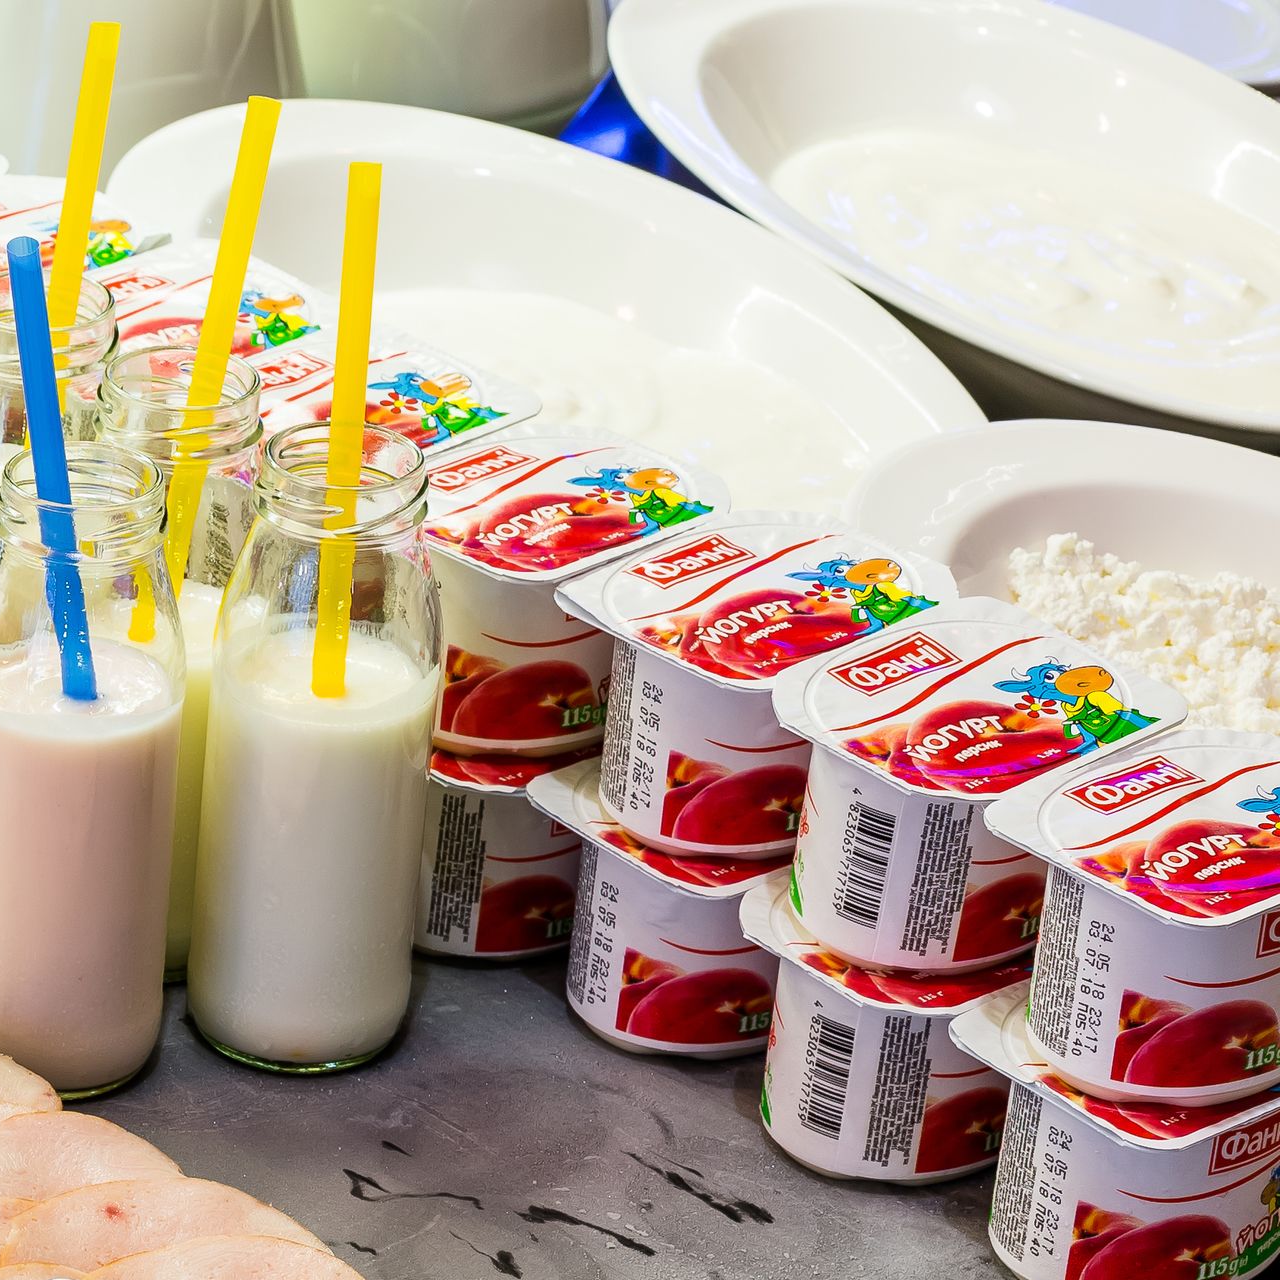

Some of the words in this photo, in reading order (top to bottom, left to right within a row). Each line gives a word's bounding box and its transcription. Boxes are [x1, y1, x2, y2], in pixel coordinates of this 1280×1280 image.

[695, 600, 795, 646] ЙОГУРТ
[743, 621, 793, 646] персик
[848, 639, 946, 687] Фанні
[903, 715, 1005, 763] ЙОГУРТ
[953, 739, 1004, 763] персик
[1085, 763, 1186, 807] Фанні
[842, 803, 860, 857] 823065
[1140, 833, 1249, 882] ЙОГУРТ
[1193, 856, 1247, 881] персик
[832, 860, 851, 911] 717159
[805, 1015, 822, 1068] 823065
[797, 1071, 813, 1122] 717159
